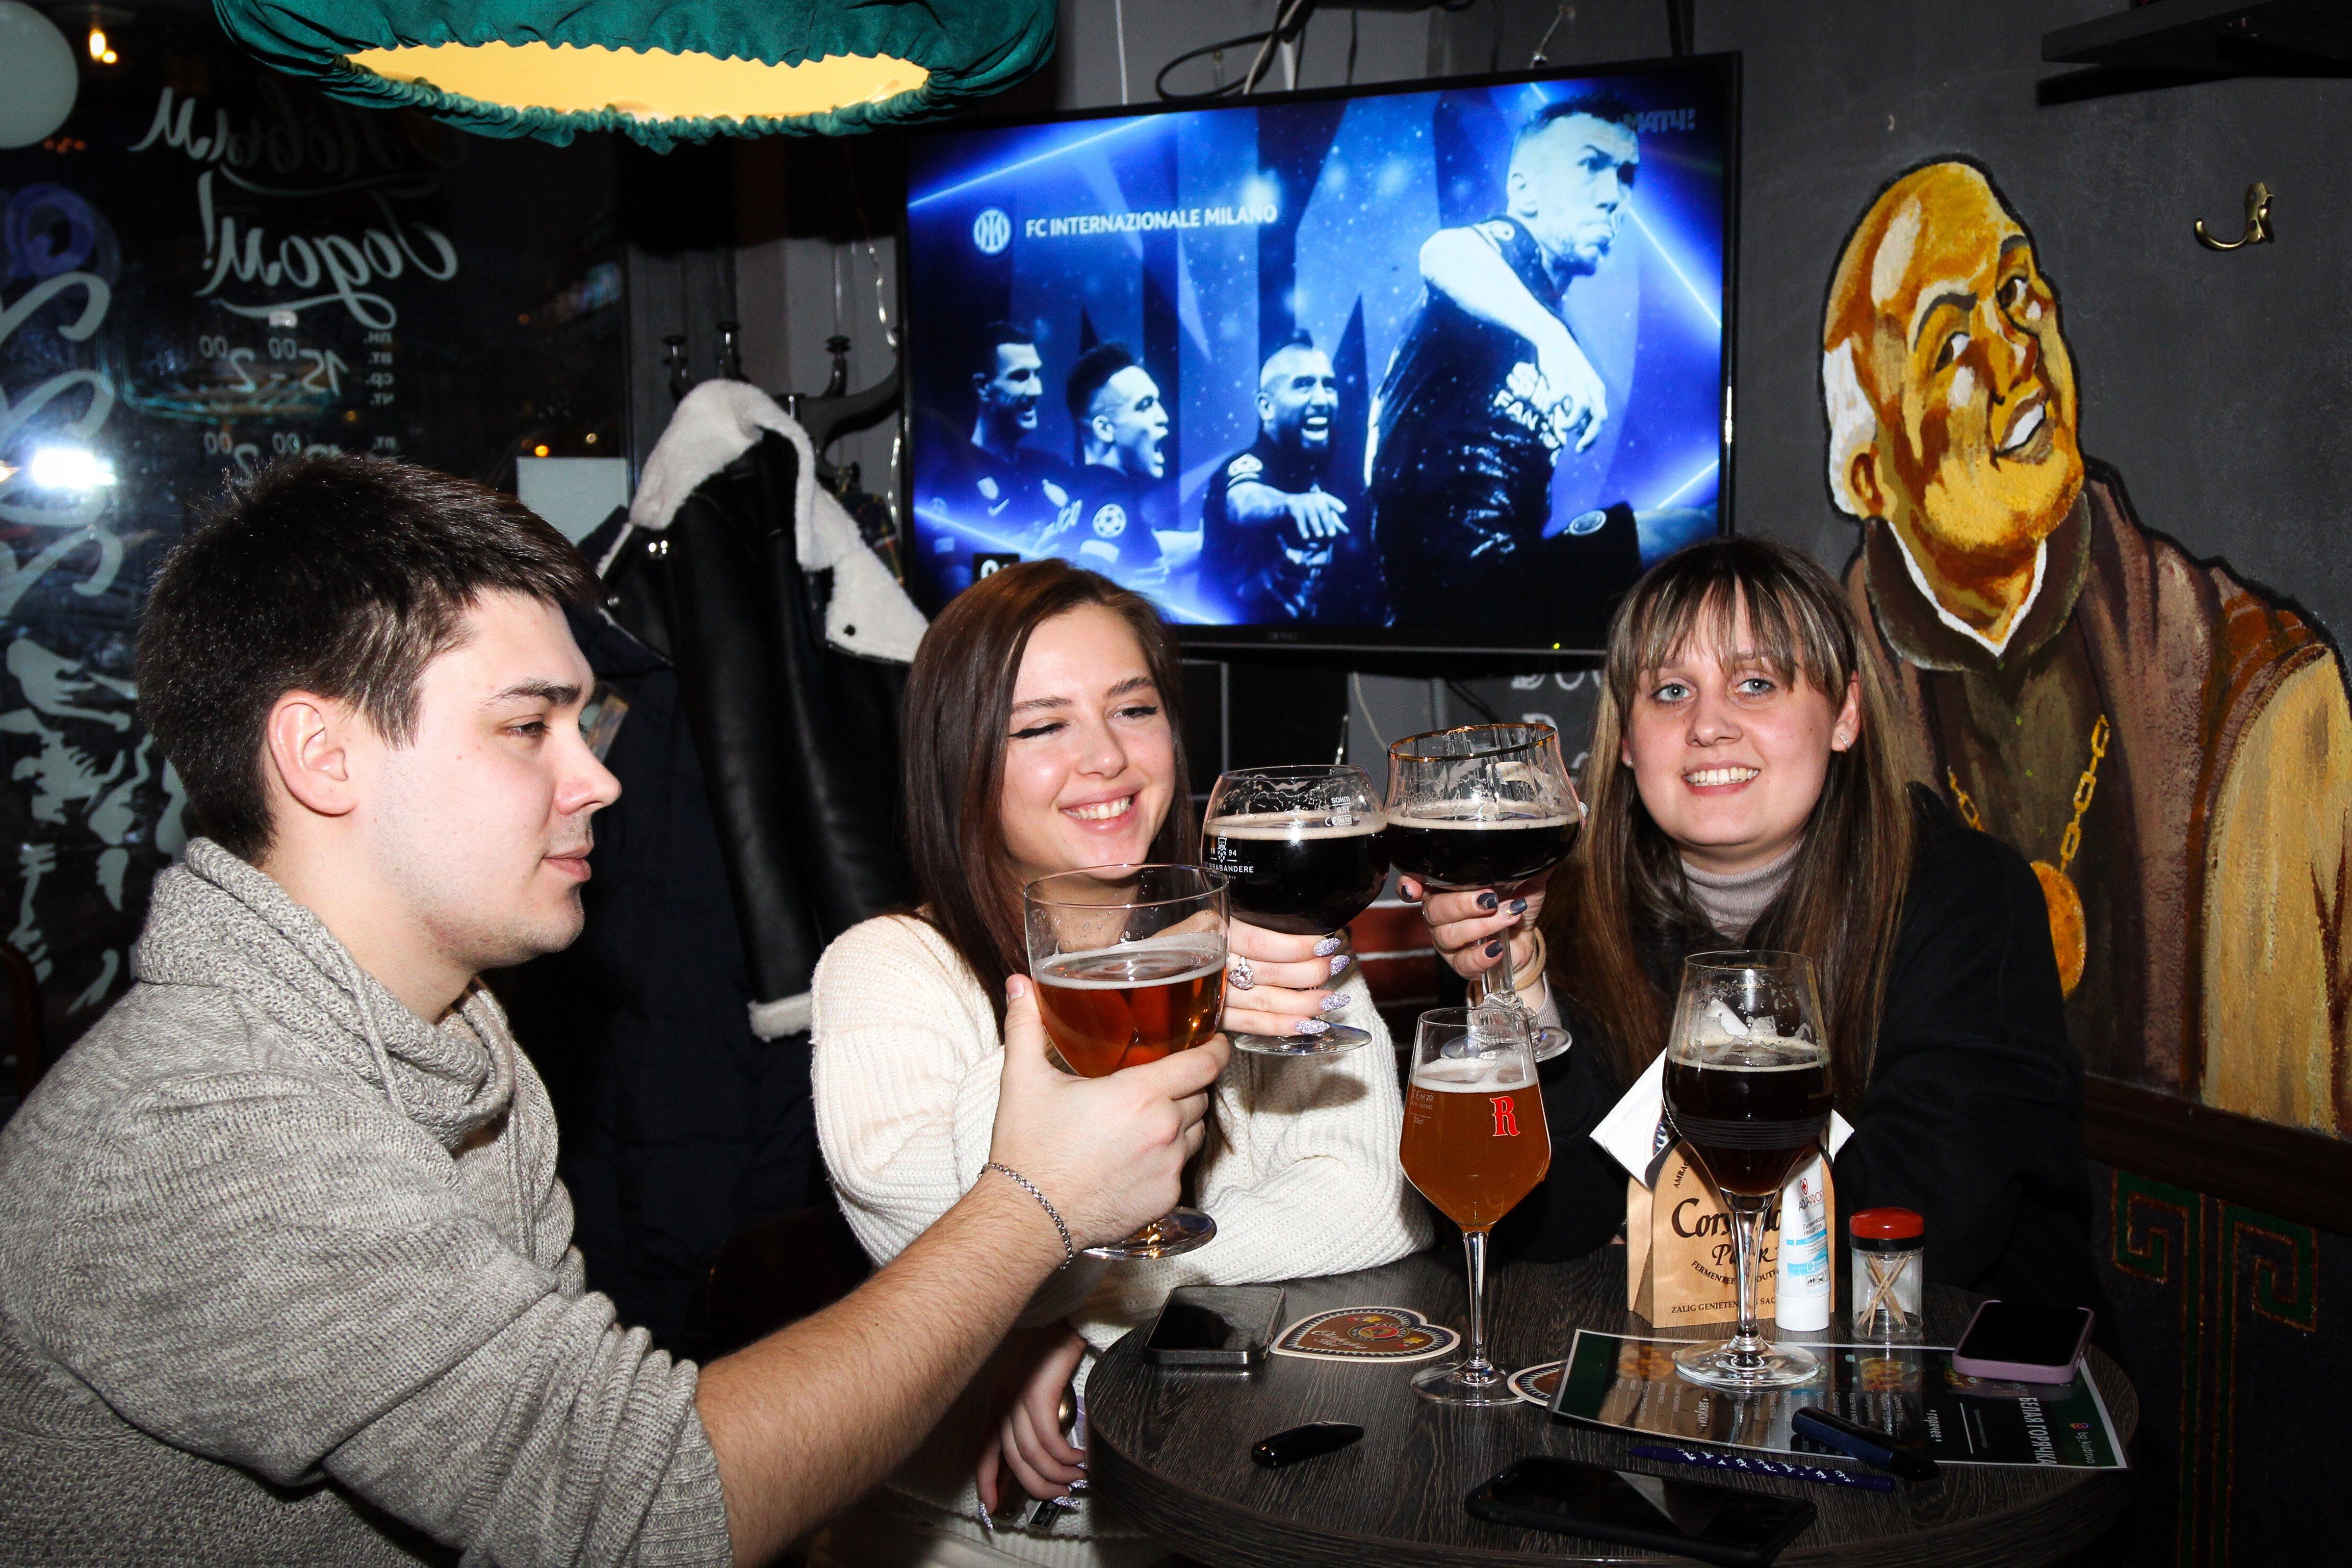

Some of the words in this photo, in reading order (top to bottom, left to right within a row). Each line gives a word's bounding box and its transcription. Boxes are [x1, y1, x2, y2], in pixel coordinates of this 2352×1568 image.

[1026, 222, 1047, 238] FC
[1050, 210, 1201, 235] INTERNAZIONALE
[1204, 205, 1278, 226] MILANO
[1493, 388, 1540, 432] FAN
[1209, 862, 1254, 874] BRABANDERE
[1489, 1095, 1521, 1137] R
[1671, 1304, 1696, 1313] ZALIG
[1693, 1401, 1709, 1424] закуски
[2017, 1396, 2044, 1424] БЕЛАЯ
[1924, 1413, 1941, 1439] горячее
[2028, 1424, 2058, 1465] ГОРЯЧКА
[2075, 1432, 2096, 1464] bg_kudrovo
